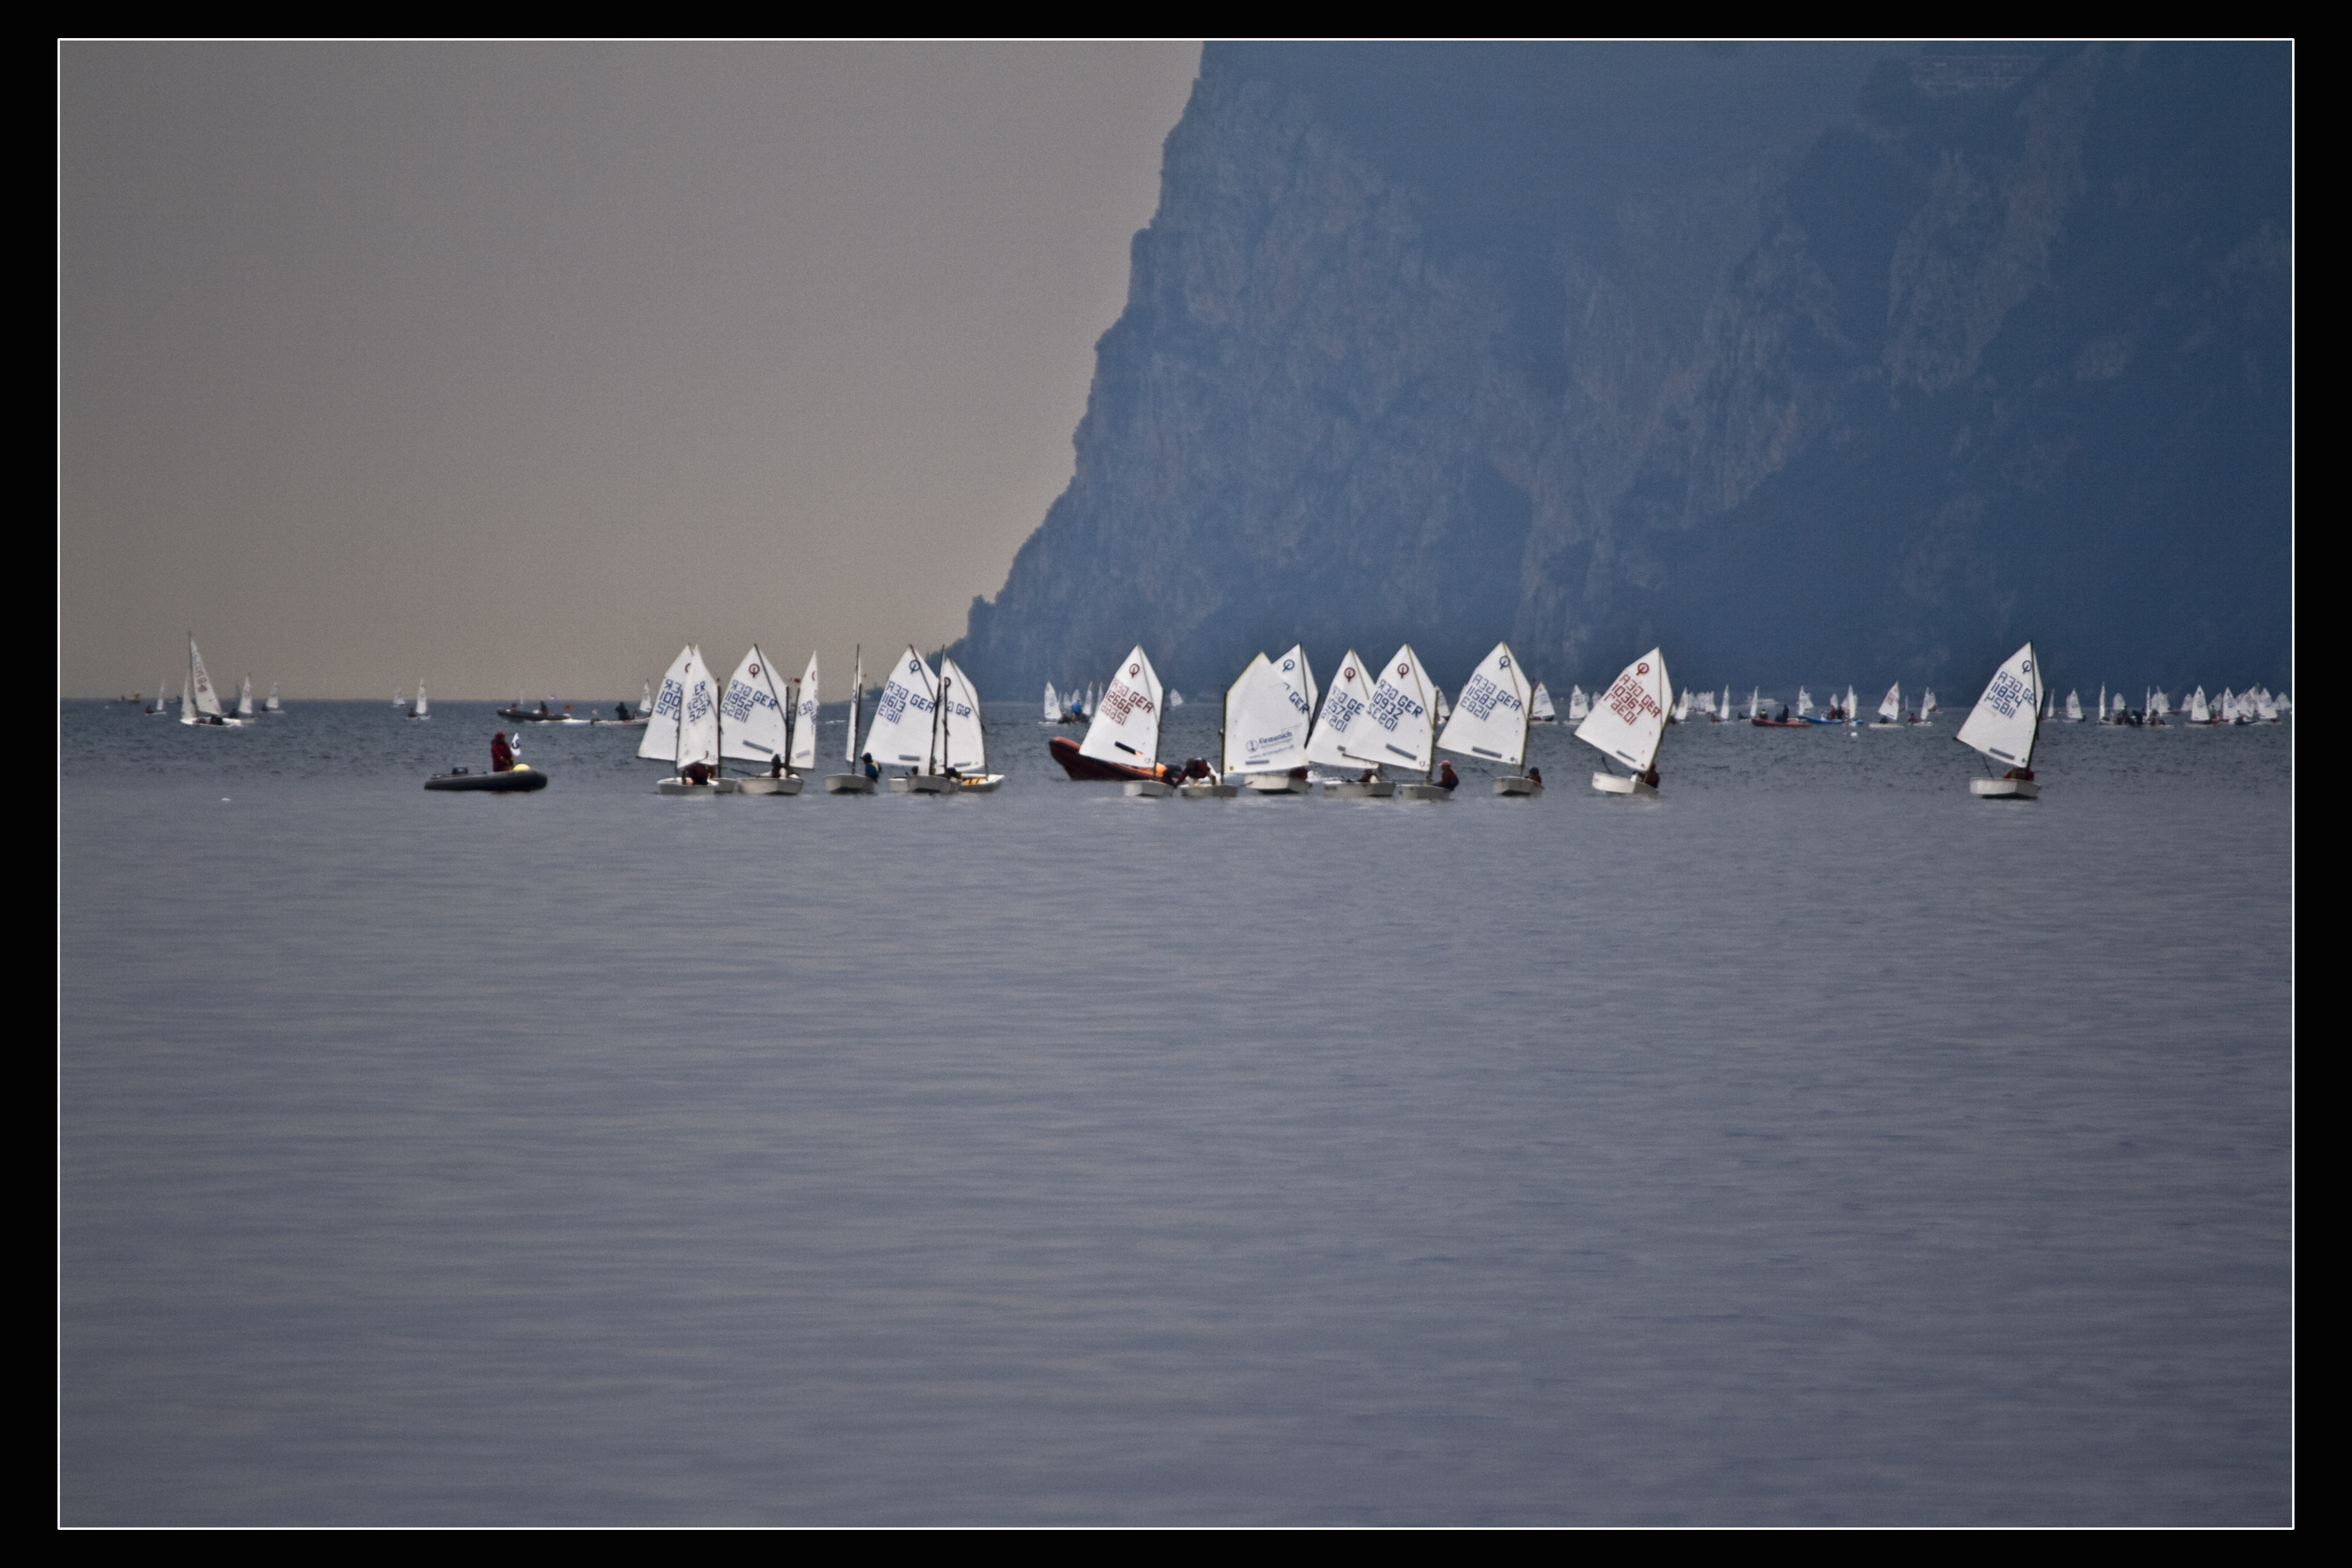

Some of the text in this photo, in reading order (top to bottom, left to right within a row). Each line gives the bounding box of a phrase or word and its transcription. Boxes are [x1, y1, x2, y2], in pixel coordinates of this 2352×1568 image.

[725, 690, 754, 712] 11952
[753, 690, 779, 710] GER
[883, 692, 906, 713] 11613
[910, 693, 936, 713] GER
[1105, 690, 1134, 714] 12666
[1129, 691, 1154, 713] GER
[1289, 691, 1310, 714] GER
[1372, 690, 1403, 720] 10932
[1397, 694, 1423, 718] GER
[1466, 685, 1497, 710] 11583
[1496, 690, 1522, 711] GER
[1612, 683, 1644, 715] 10367
[1641, 694, 1661, 718] GER
[1991, 682, 2022, 708] 11824
[2022, 687, 2034, 707] GE
[1347, 698, 1365, 715] GE
